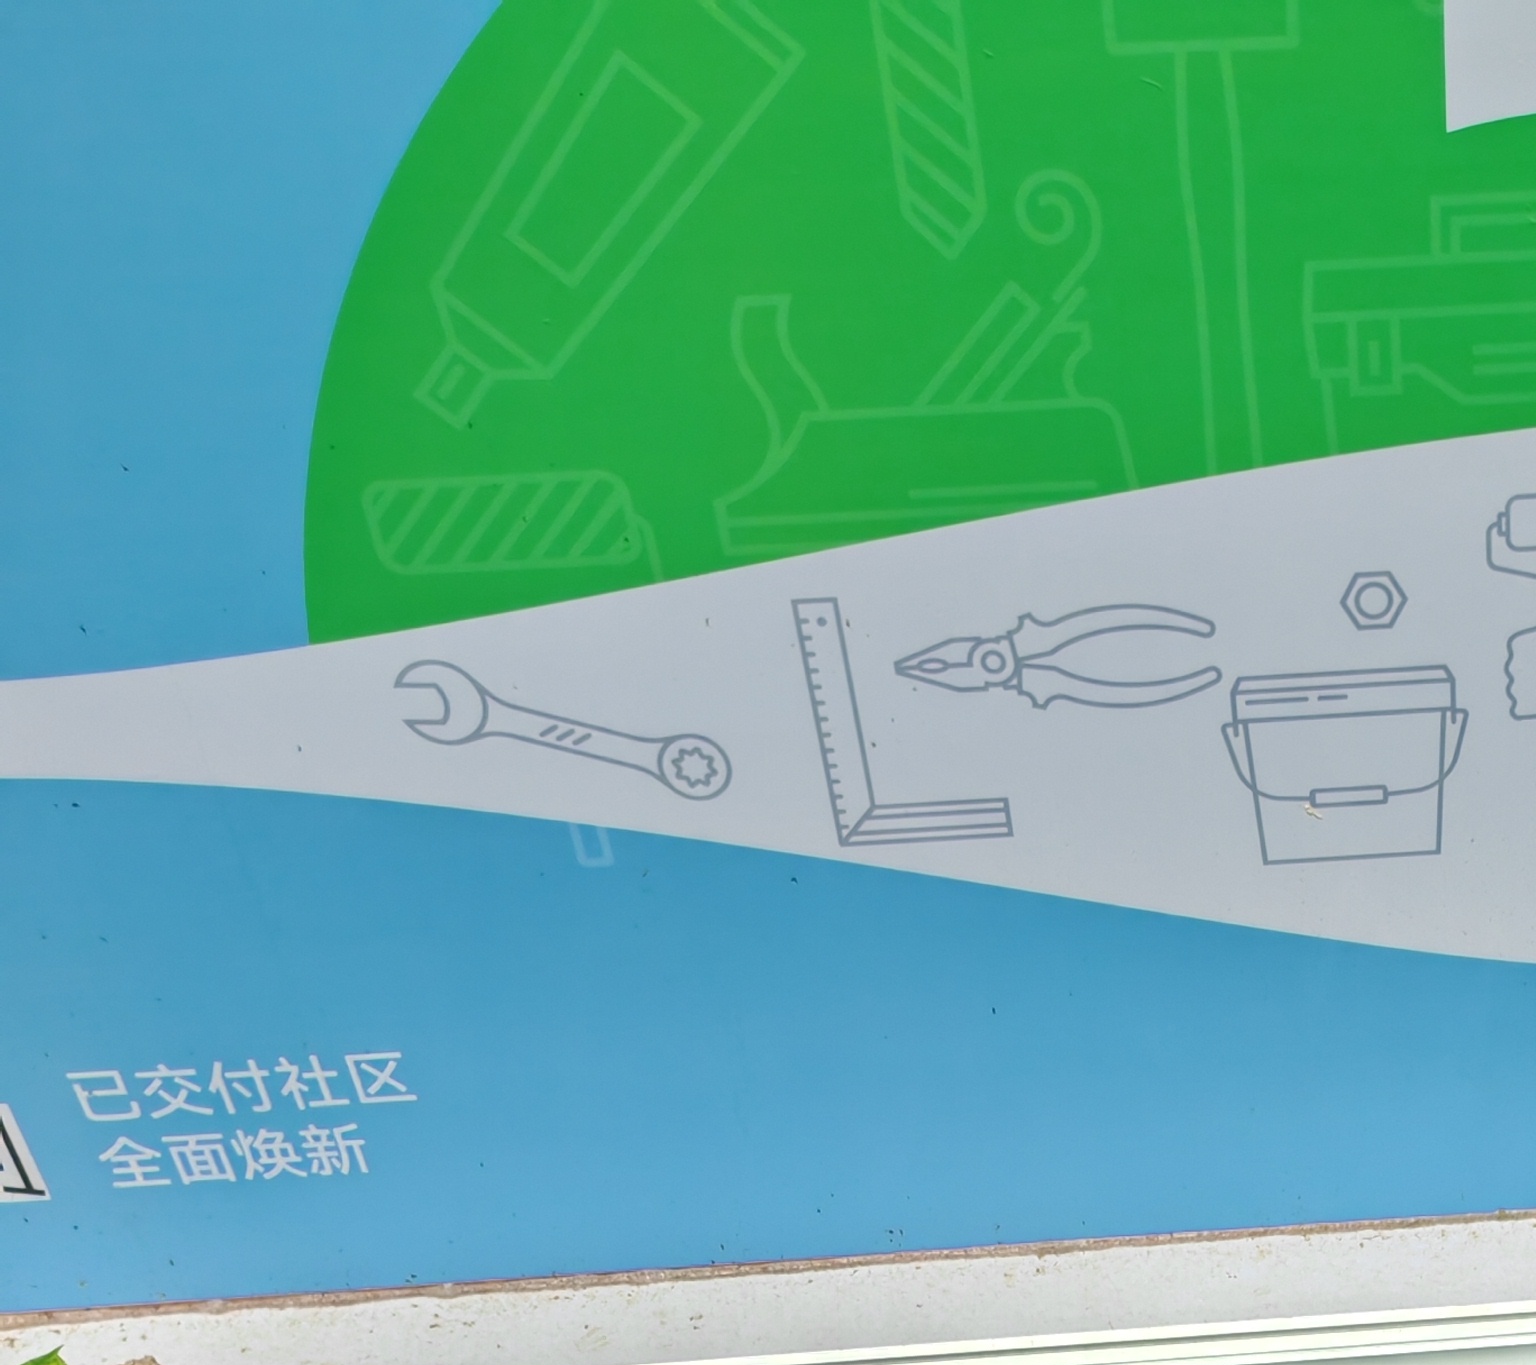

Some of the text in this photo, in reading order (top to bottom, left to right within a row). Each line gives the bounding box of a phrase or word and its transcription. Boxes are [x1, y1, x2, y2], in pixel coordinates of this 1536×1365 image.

[65, 1051, 418, 1122] 已交付社区
[98, 1123, 370, 1188] 全面焕新
